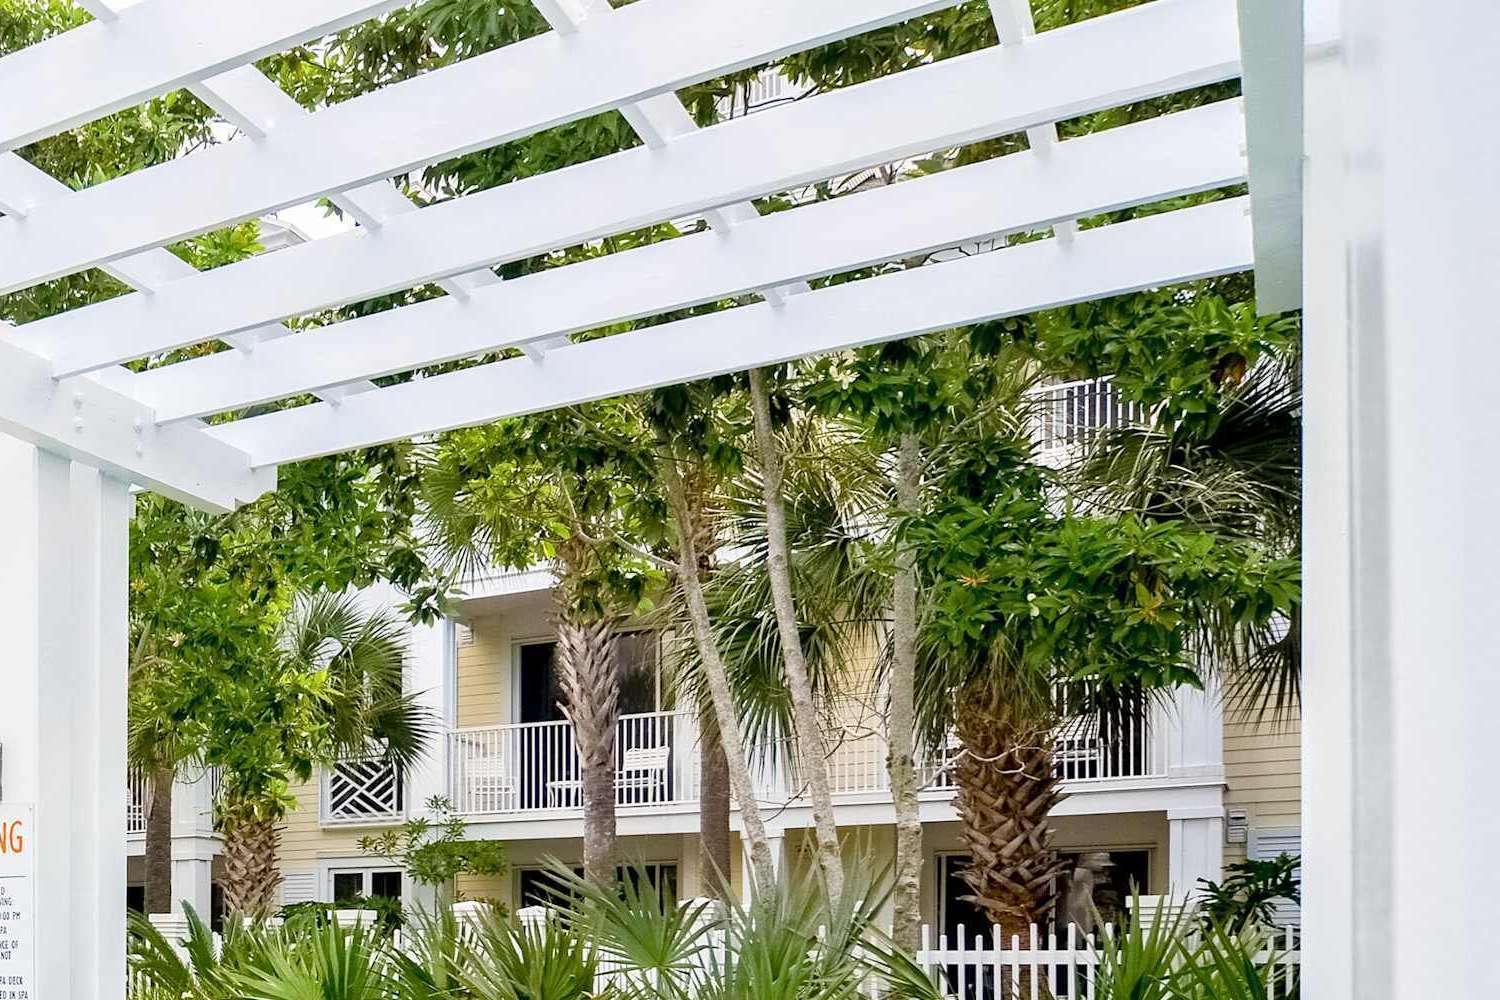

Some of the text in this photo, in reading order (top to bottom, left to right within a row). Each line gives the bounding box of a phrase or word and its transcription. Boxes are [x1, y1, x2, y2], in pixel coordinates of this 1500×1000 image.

[12, 940, 18, 949] OF
[1, 951, 11, 960] NOT
[9, 977, 23, 985] DECK
[10, 991, 16, 999] IN
[18, 991, 28, 999] SPA
